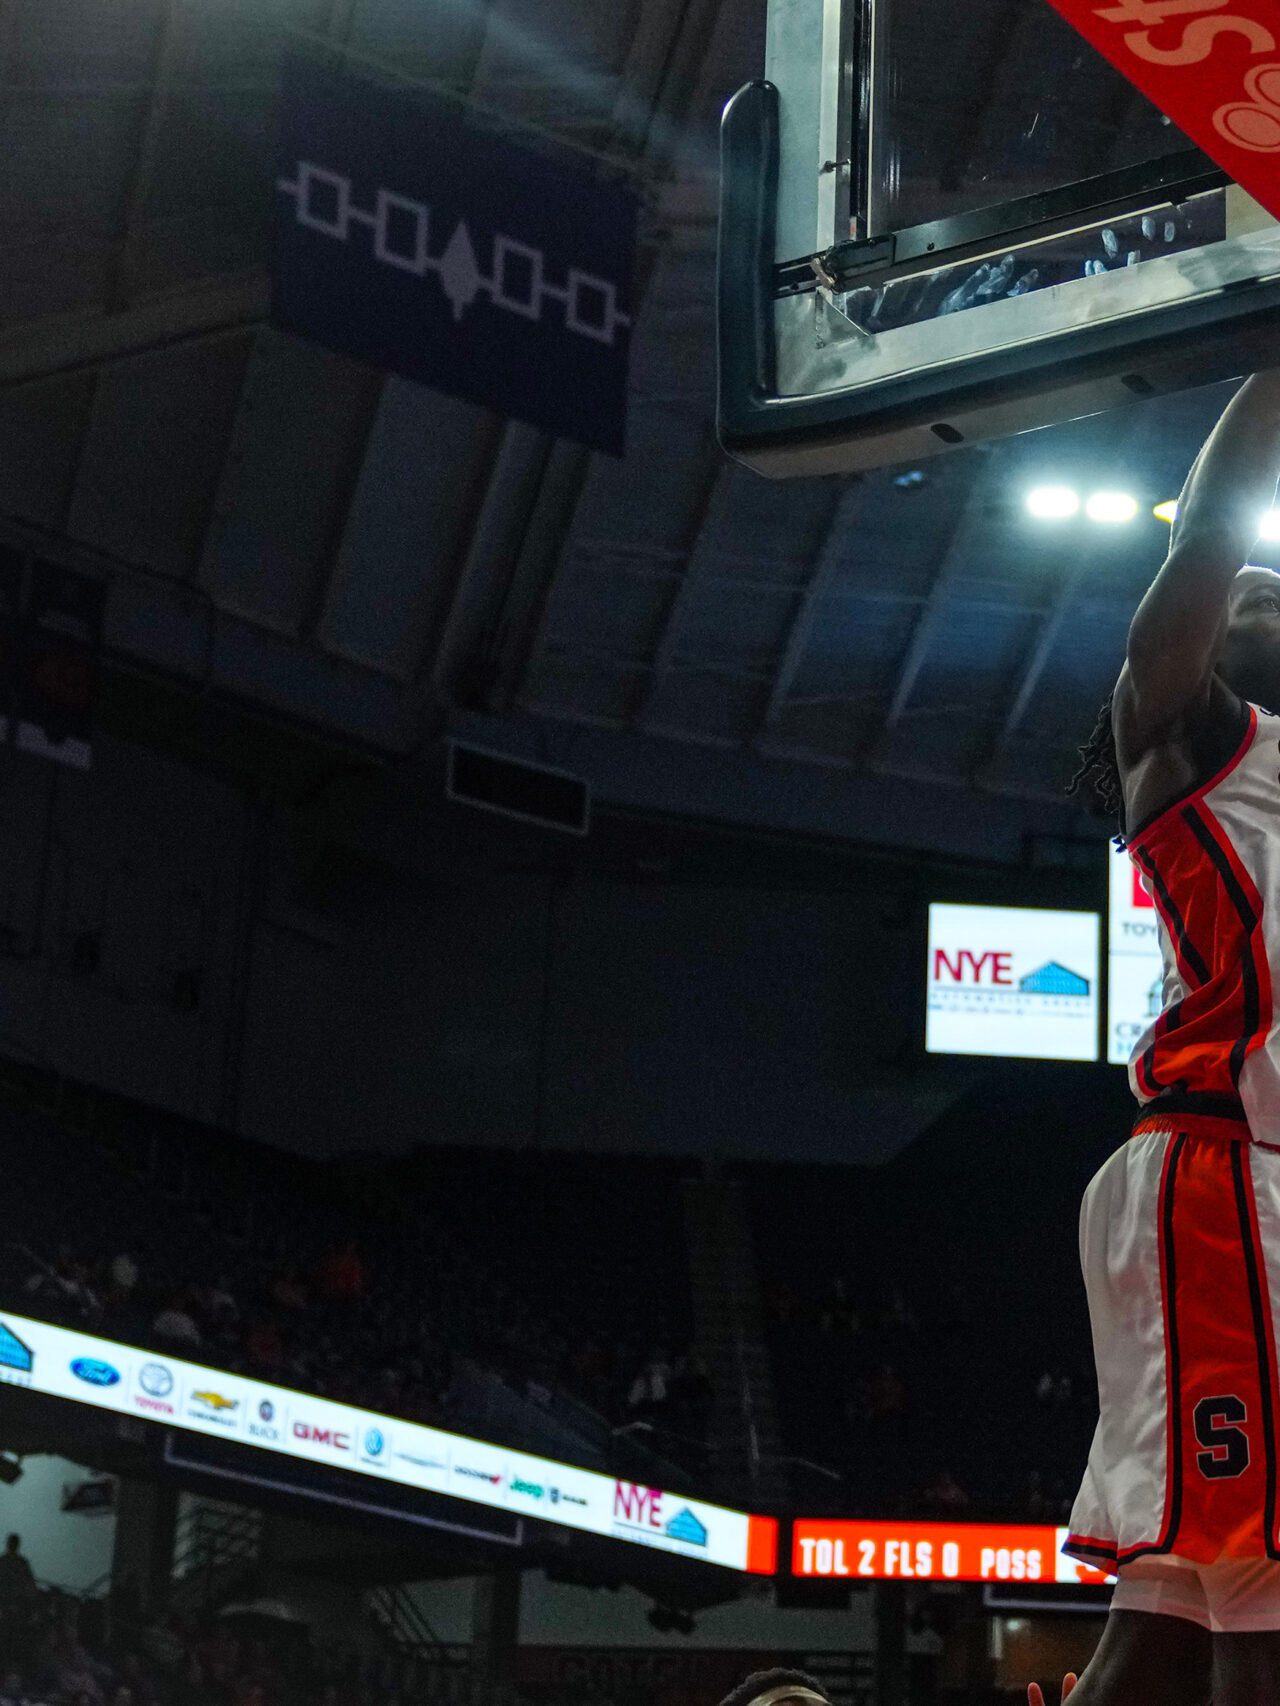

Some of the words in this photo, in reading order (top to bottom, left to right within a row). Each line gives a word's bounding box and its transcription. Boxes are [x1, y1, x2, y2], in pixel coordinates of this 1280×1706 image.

[934, 948, 1013, 985] NYE
[293, 1421, 350, 1451] GMC
[1193, 1394, 1250, 1480] S
[510, 1476, 544, 1499] Jeep
[614, 1479, 662, 1528] NYE
[800, 1538, 849, 1575] TOL
[858, 1540, 876, 1576] 2
[885, 1541, 932, 1578] FLS
[981, 1548, 1042, 1580] POSS
